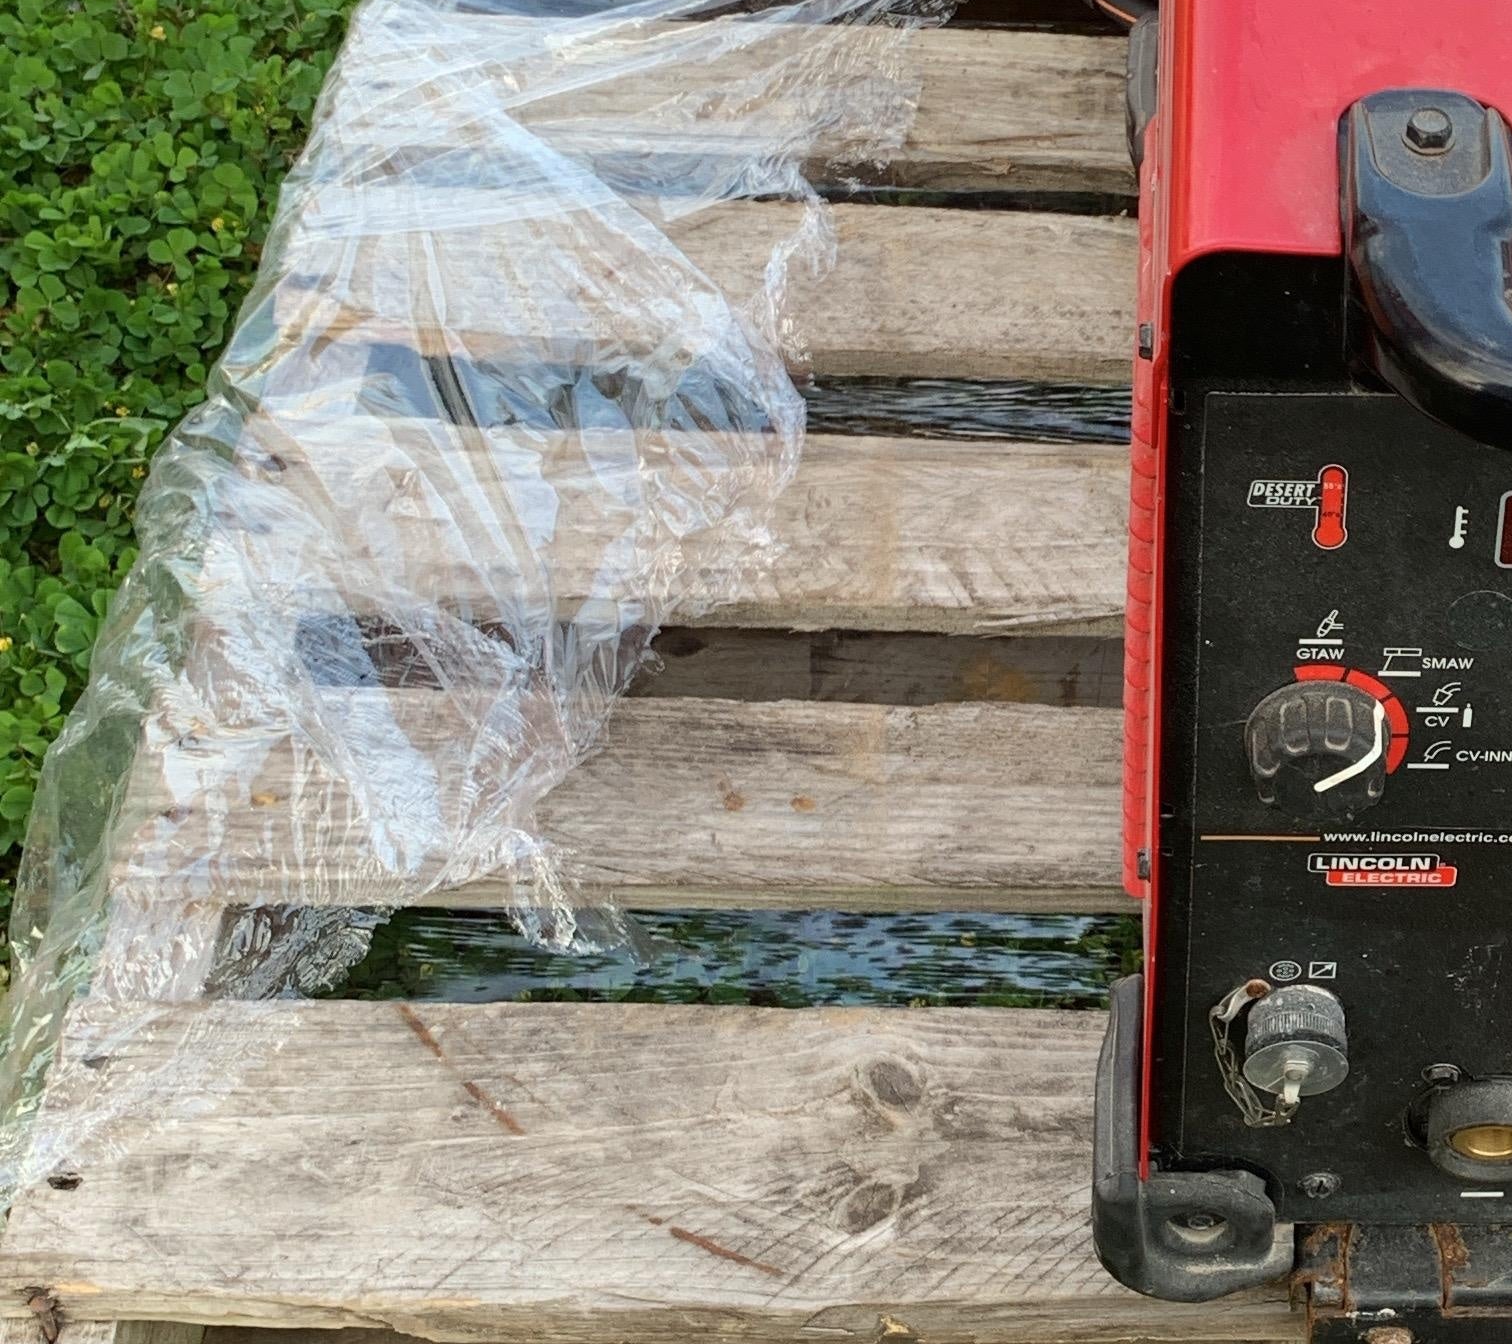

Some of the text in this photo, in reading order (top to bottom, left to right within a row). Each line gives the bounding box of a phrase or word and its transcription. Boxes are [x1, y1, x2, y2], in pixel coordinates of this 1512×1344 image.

[1252, 483, 1316, 497] DESERT
[1265, 496, 1318, 506] DUTY
[1296, 648, 1345, 661] GTAW
[1421, 657, 1474, 670] SMAW
[1424, 715, 1451, 728] CV
[1315, 856, 1432, 871] LINCOLN
[1340, 872, 1443, 885] ELECTRIC
